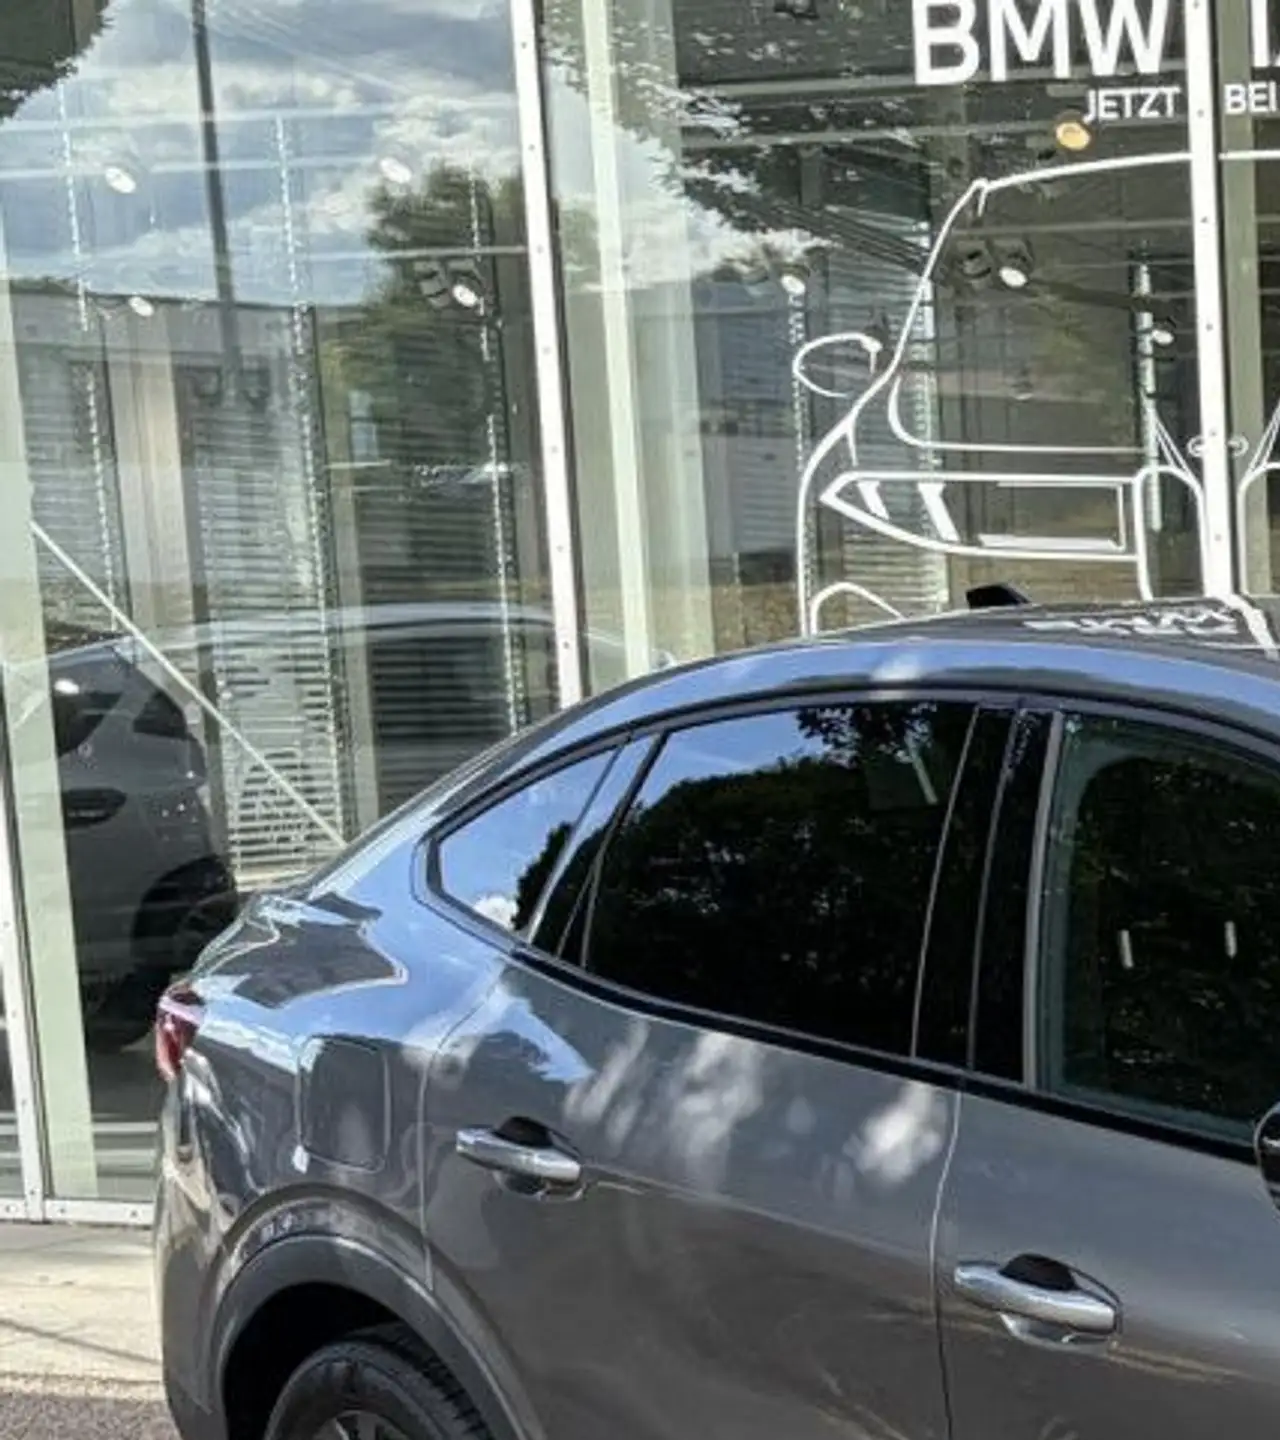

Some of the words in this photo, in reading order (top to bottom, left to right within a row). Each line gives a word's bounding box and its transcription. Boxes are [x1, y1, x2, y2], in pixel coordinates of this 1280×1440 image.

[914, 0, 1168, 86] BMW
[1084, 84, 1182, 122] JETZT
[1224, 80, 1277, 115] BEI
